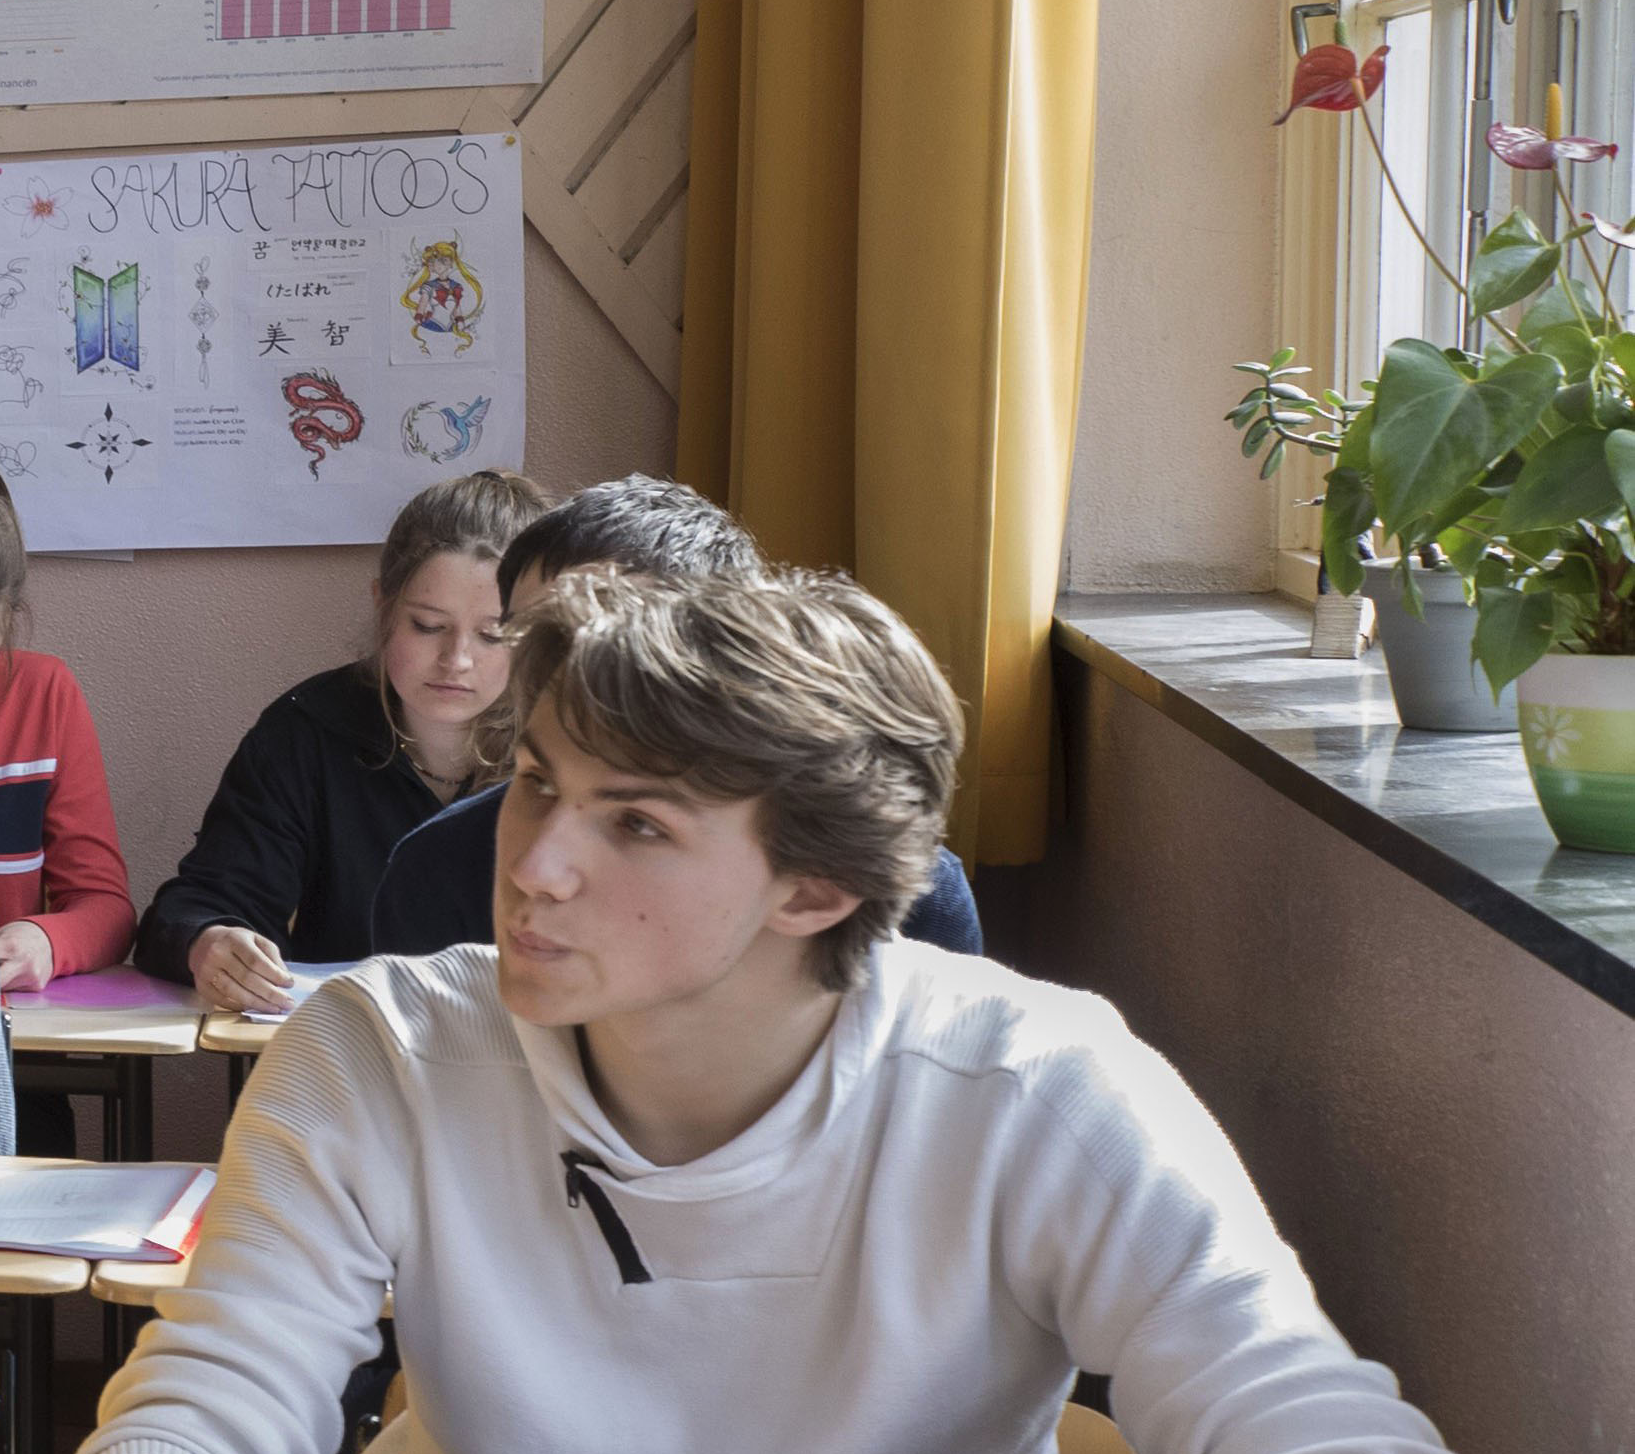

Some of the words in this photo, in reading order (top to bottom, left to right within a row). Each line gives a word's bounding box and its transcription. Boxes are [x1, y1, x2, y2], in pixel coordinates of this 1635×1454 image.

[89, 158, 271, 234] SAKURA
[266, 282, 331, 297] くたばれ
[259, 325, 295, 356] 美
[321, 319, 350, 346] 智
